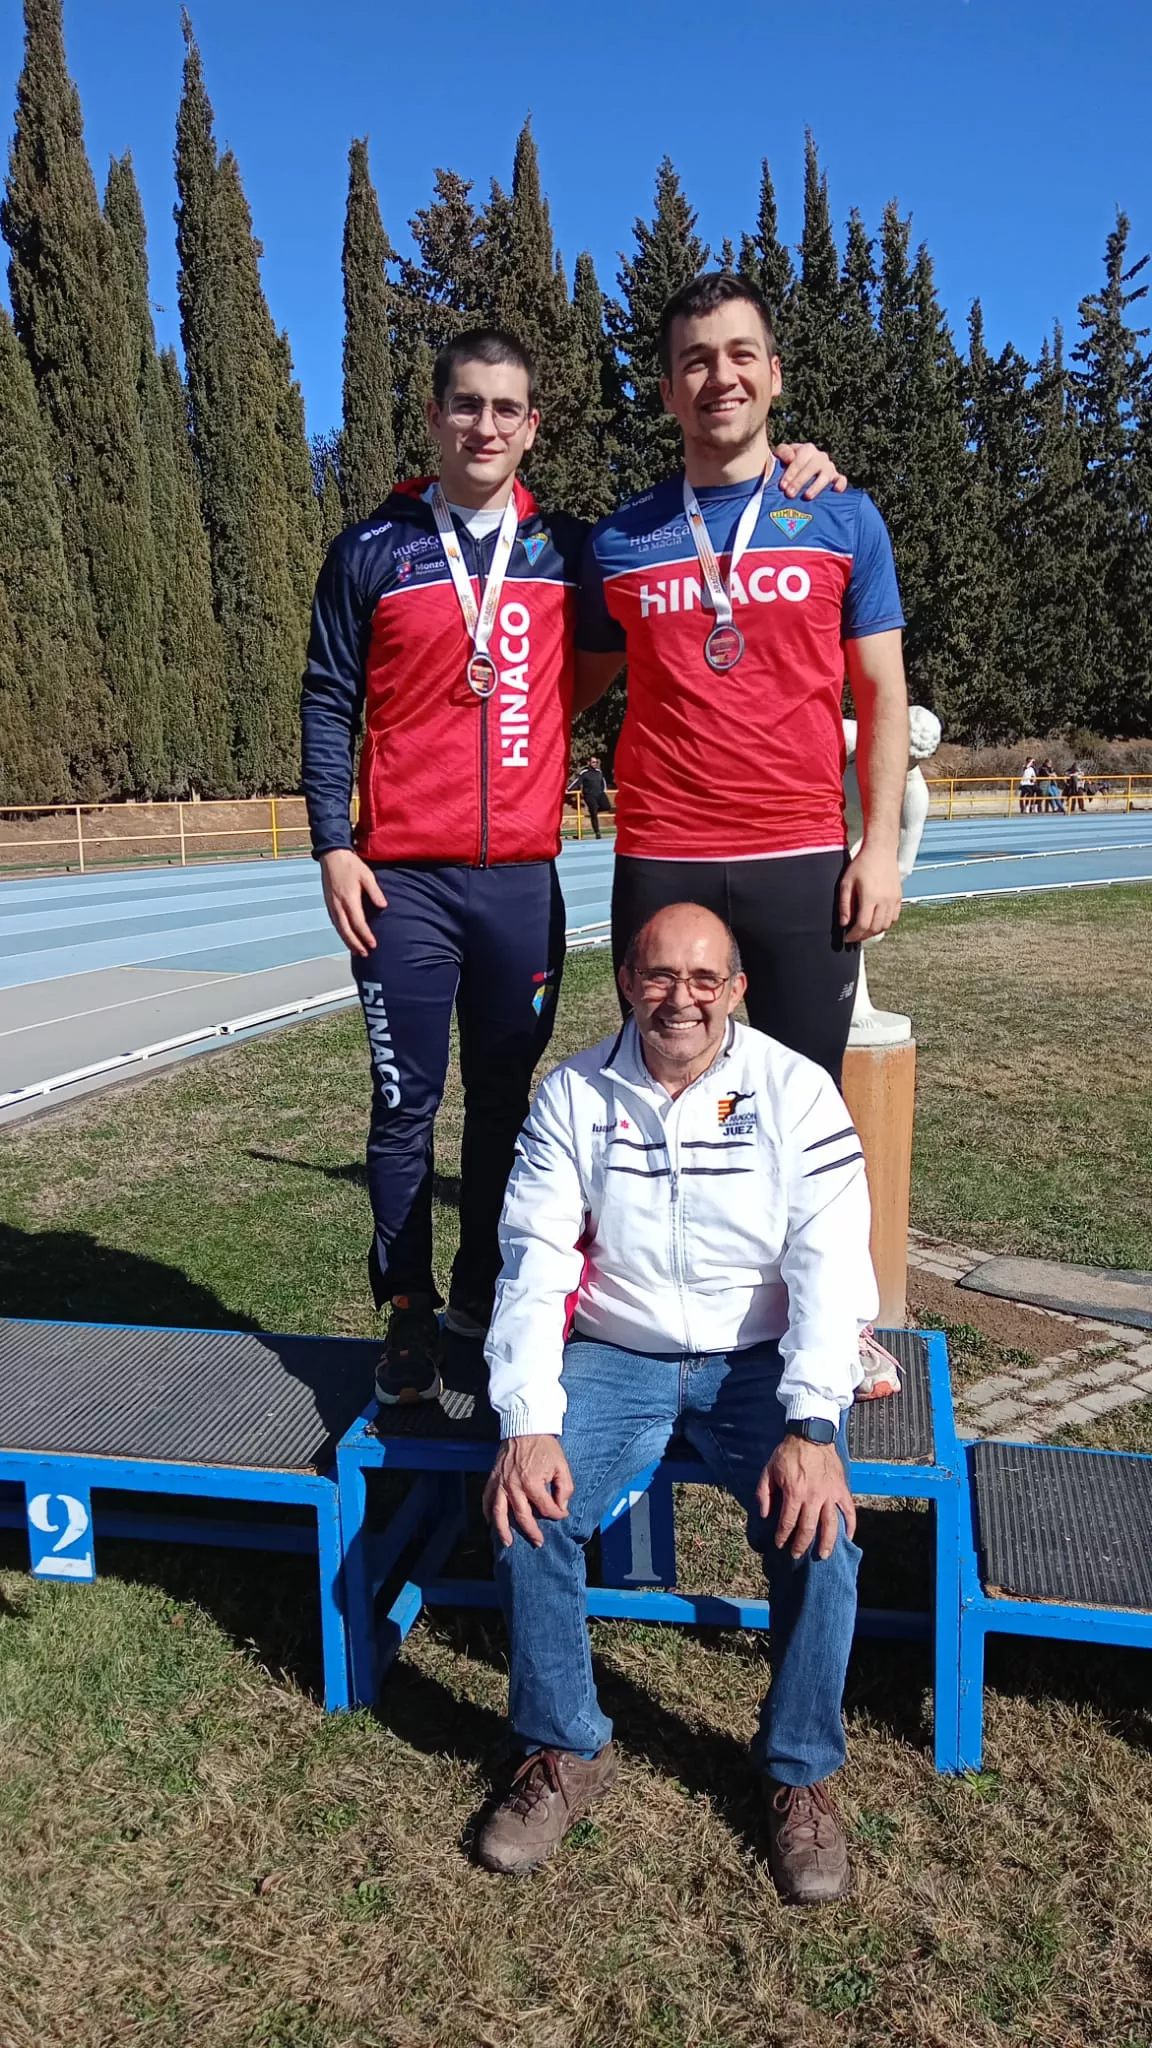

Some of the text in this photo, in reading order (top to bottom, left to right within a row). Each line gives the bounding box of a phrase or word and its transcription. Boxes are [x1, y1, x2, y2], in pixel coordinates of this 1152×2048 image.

[415, 560, 446, 571] Monzó
[640, 565, 811, 619] HINACO
[500, 601, 531, 767] HINACO
[362, 981, 401, 1109] HINACO
[722, 1125, 754, 1137] JUEZ
[27, 1493, 93, 1578] 2
[612, 1490, 663, 1581] 1
